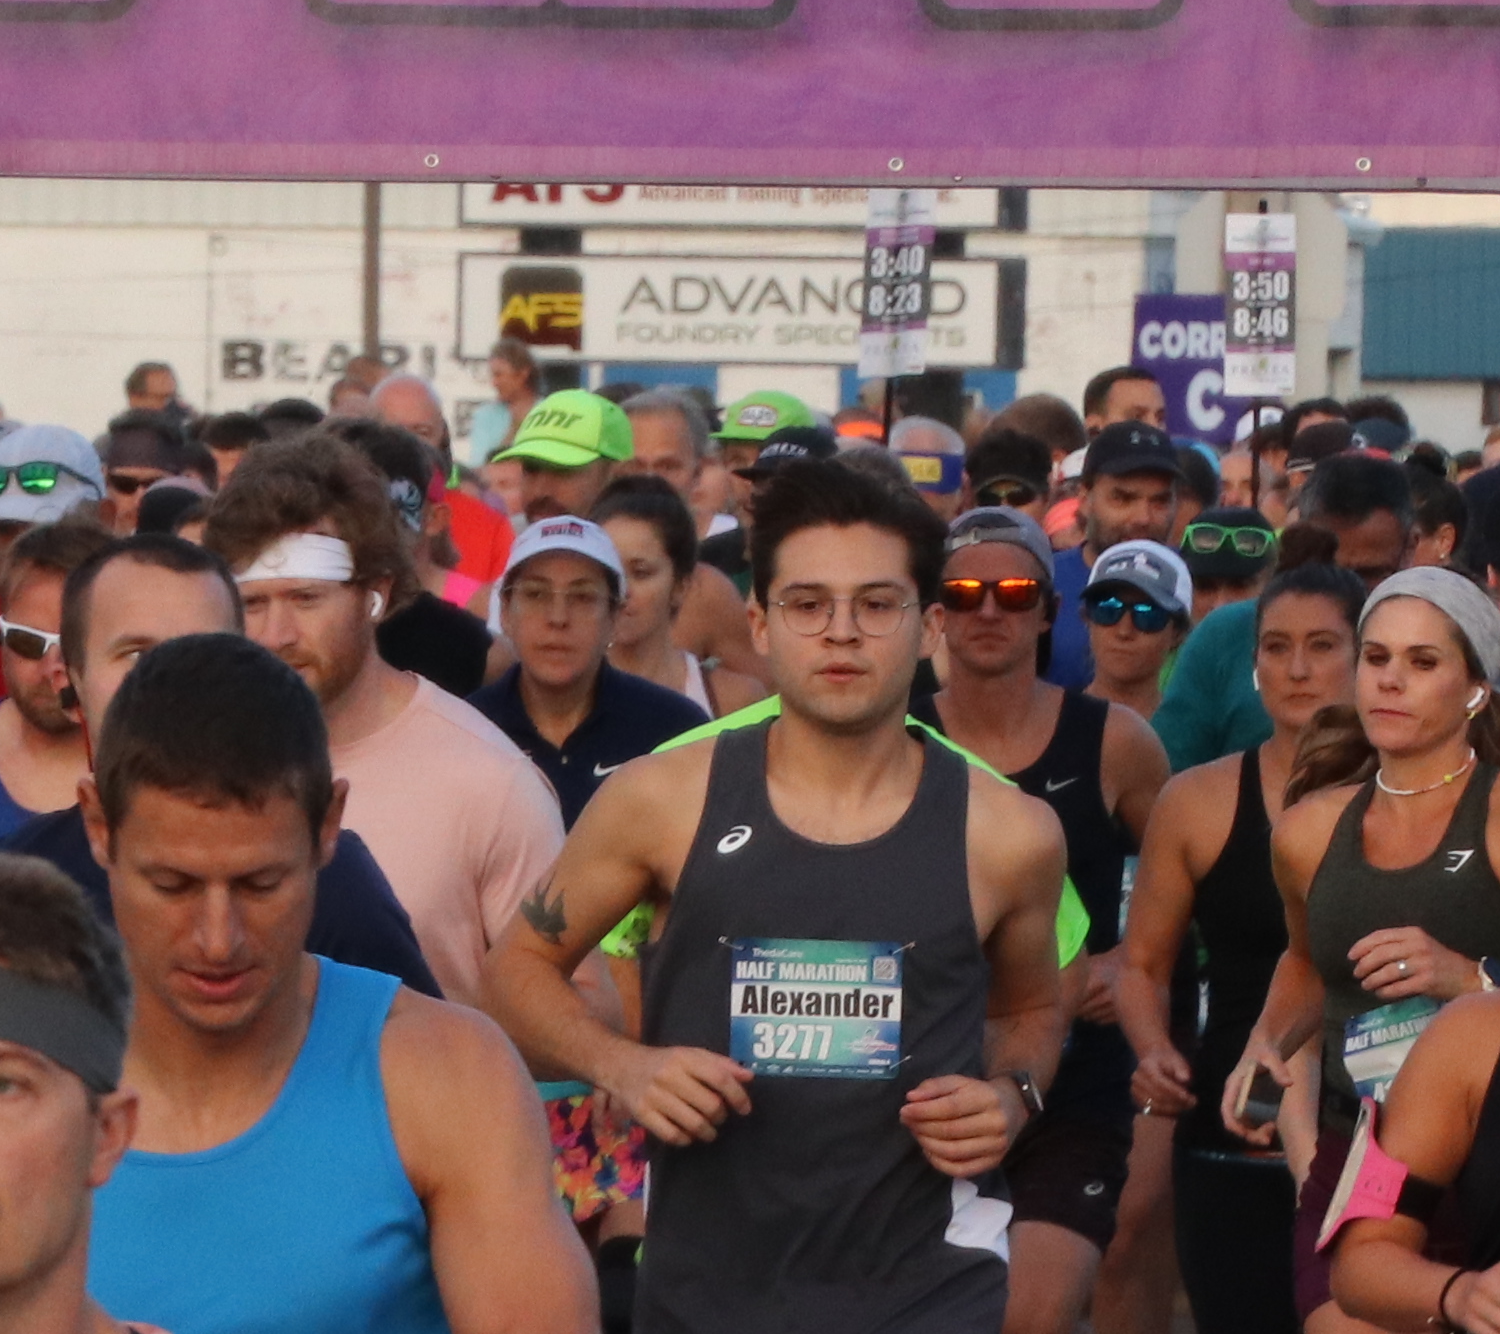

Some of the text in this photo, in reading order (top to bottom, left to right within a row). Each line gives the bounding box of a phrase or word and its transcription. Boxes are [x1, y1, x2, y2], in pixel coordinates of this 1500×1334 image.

[871, 245, 925, 279] 3:40
[868, 281, 922, 317] 8:23
[1233, 270, 1290, 302] 3:50
[616, 322, 757, 344] FOUNDRY
[1233, 306, 1290, 338] 8:46
[736, 960, 868, 983] HALF MARATHON
[740, 985, 894, 1019] Alexander
[752, 1022, 834, 1061] 3277
